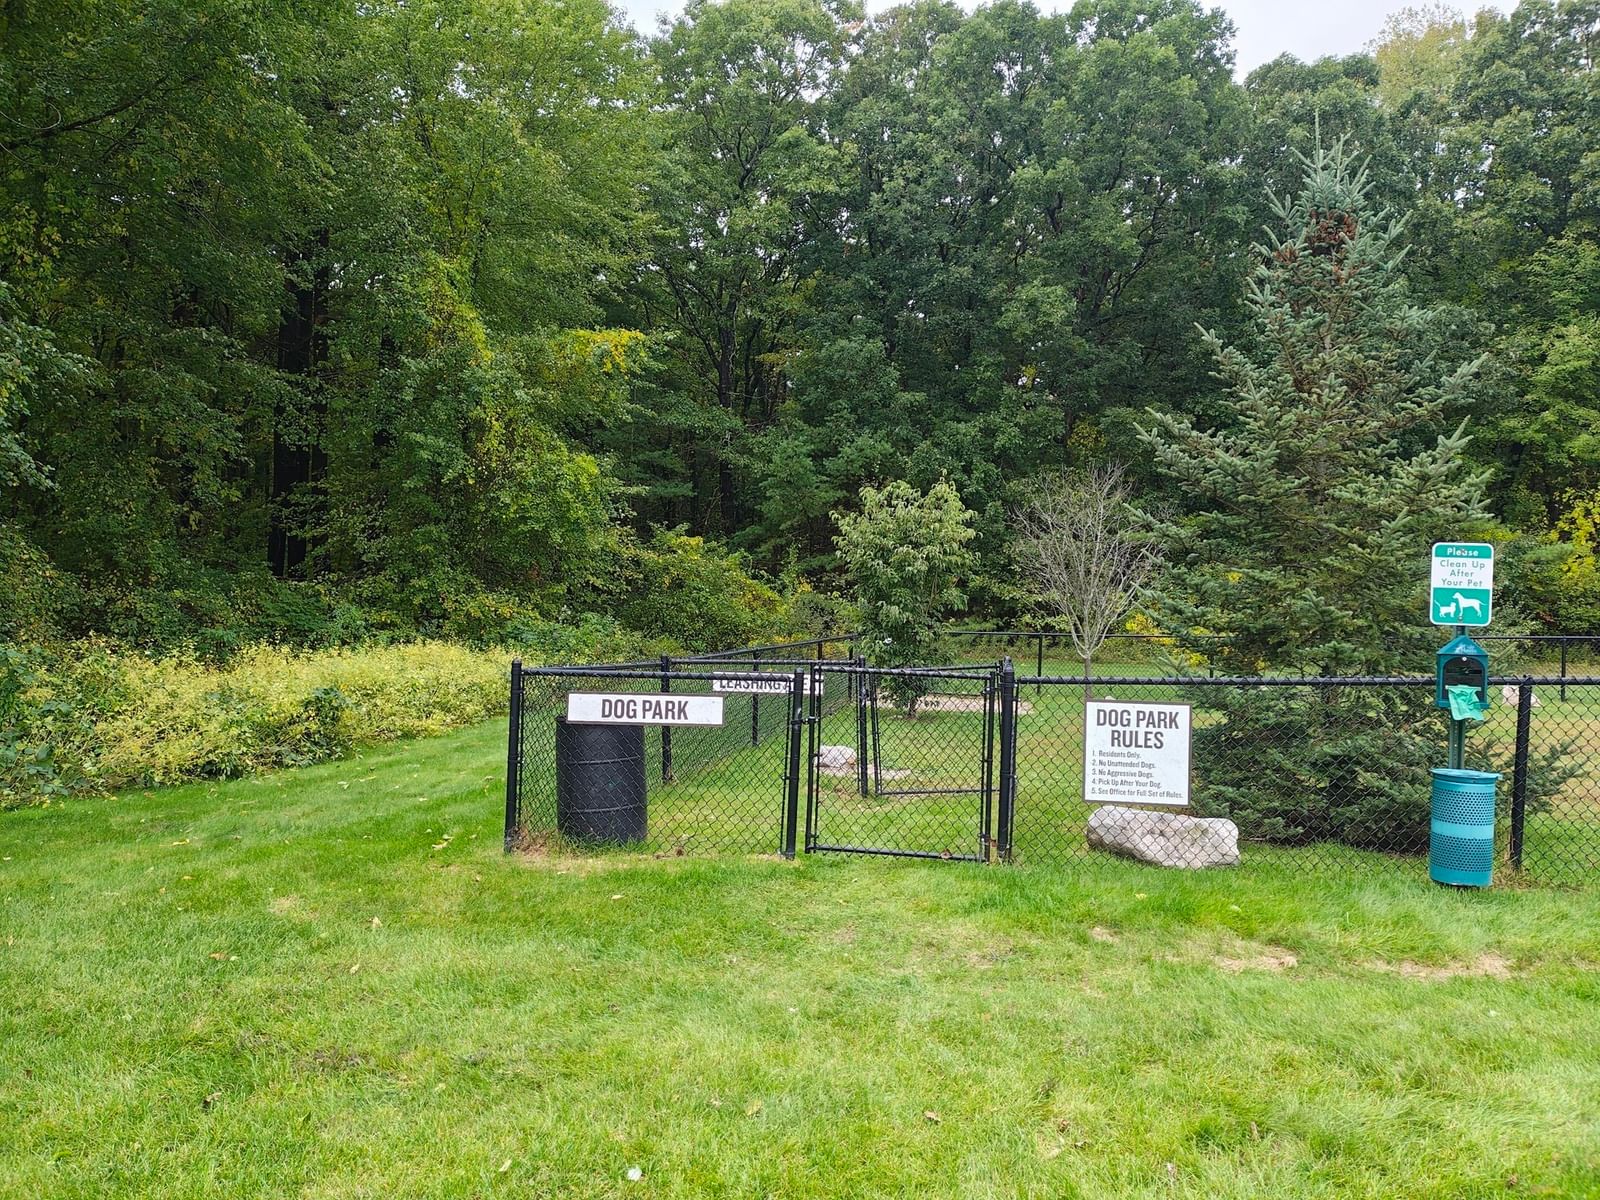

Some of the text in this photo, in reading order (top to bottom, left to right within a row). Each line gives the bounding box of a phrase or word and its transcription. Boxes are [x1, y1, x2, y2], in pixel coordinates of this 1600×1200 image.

[1447, 547, 1478, 556] Please
[1440, 560, 1485, 570] Clean Up
[1450, 569, 1474, 577] After
[601, 698, 688, 720] DOG PARK
[1096, 708, 1179, 729] DOG PARK
[1111, 730, 1164, 749] RULES
